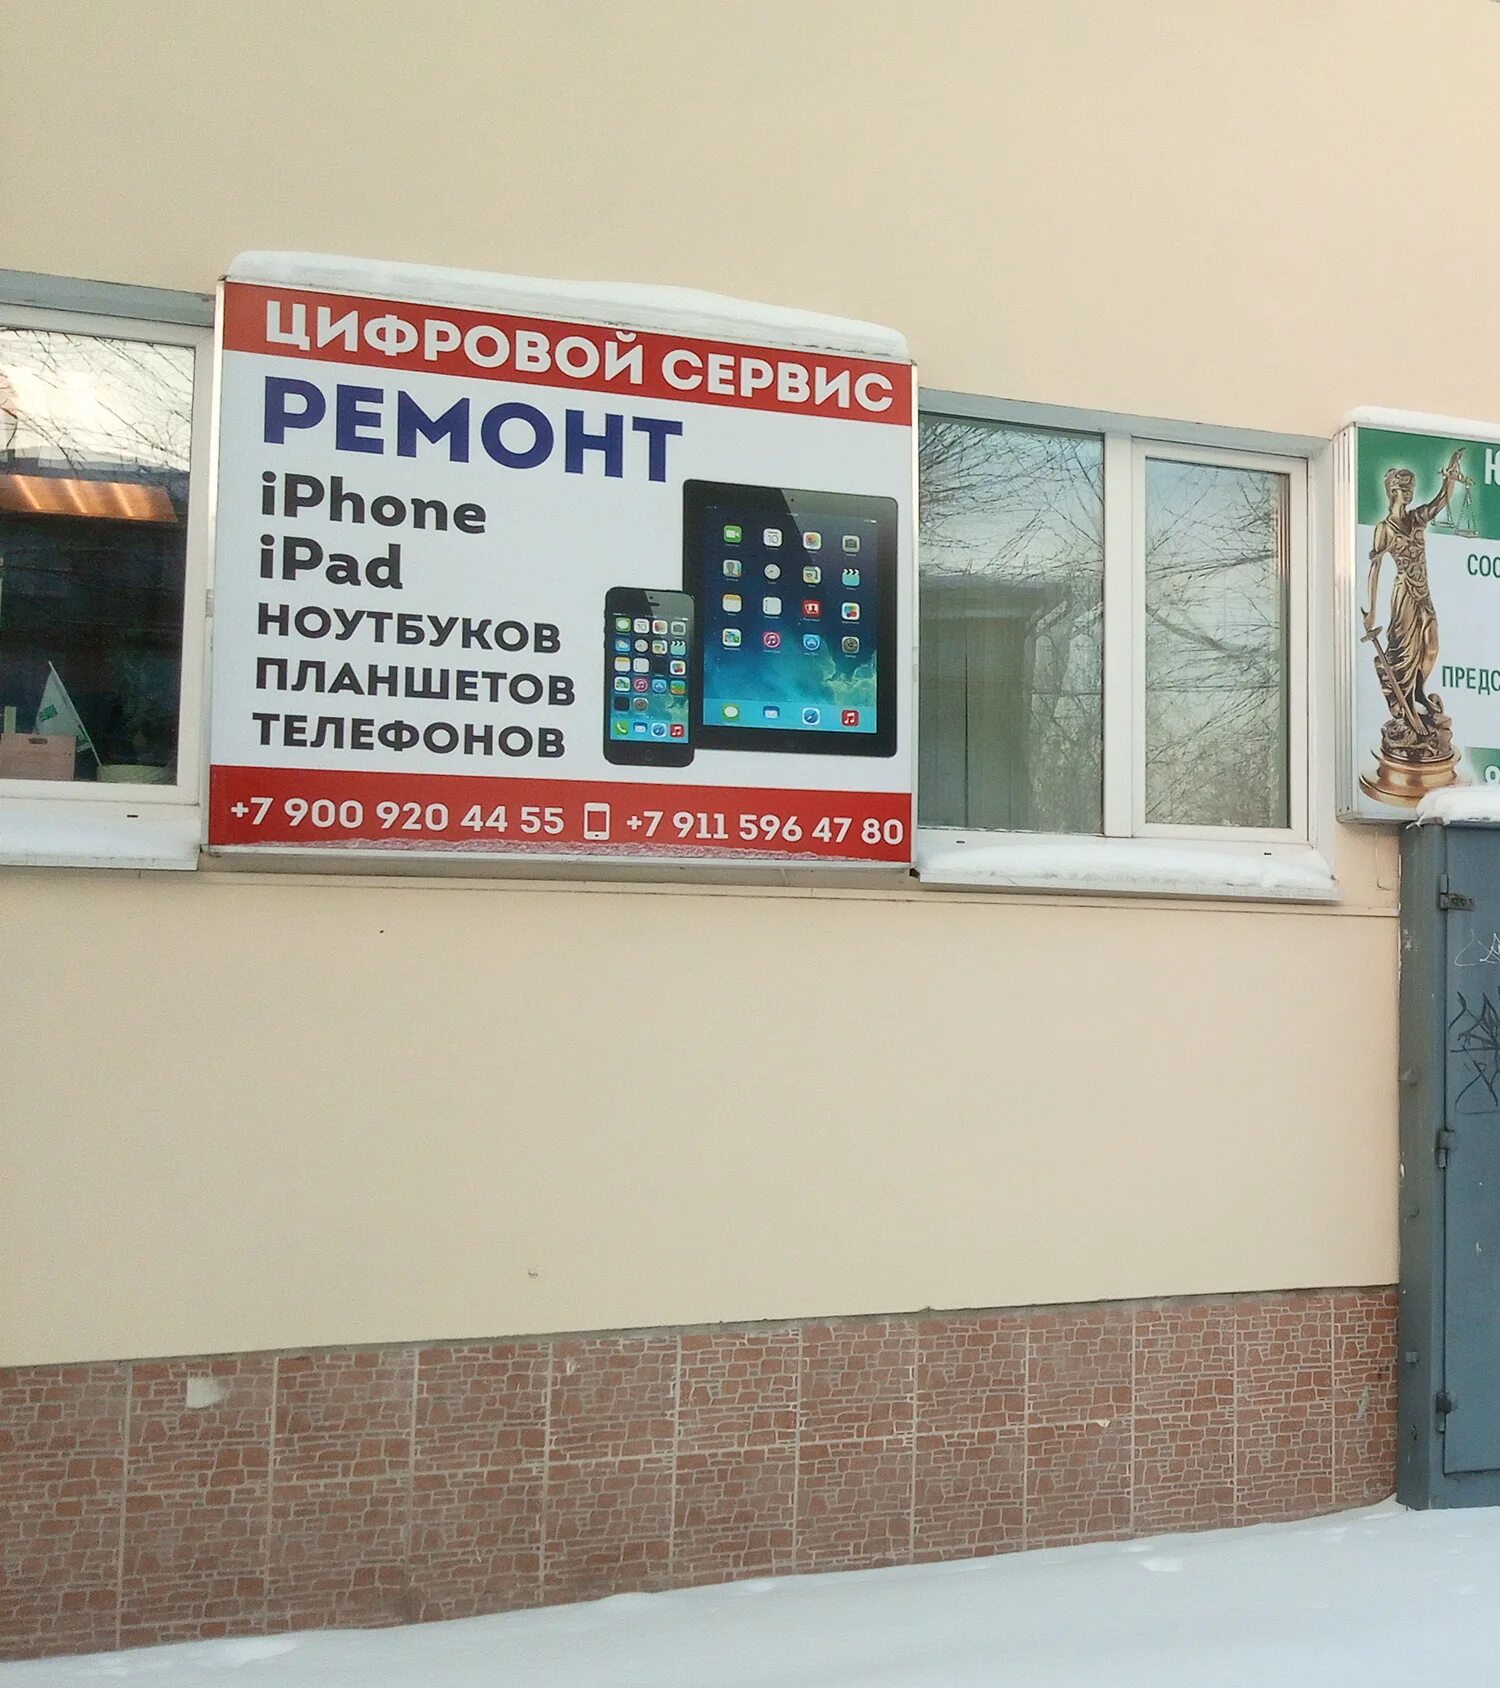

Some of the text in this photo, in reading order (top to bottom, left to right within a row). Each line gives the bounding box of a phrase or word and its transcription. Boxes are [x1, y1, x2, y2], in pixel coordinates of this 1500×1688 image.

[265, 299, 893, 413] ЦИФРОВОЙ СЕРВИС
[263, 375, 684, 483] РЕМОНТ
[262, 471, 485, 534] iPhone
[261, 534, 403, 589] iPad
[258, 603, 560, 653] НОУТБУКОВ
[256, 657, 574, 705] ПЛАНШЕТОВ
[252, 712, 564, 758] ТЕЛЕФОНОВ
[231, 797, 564, 834] +7 900 920 44 55
[626, 810, 903, 844] +7 911 596 47 80
